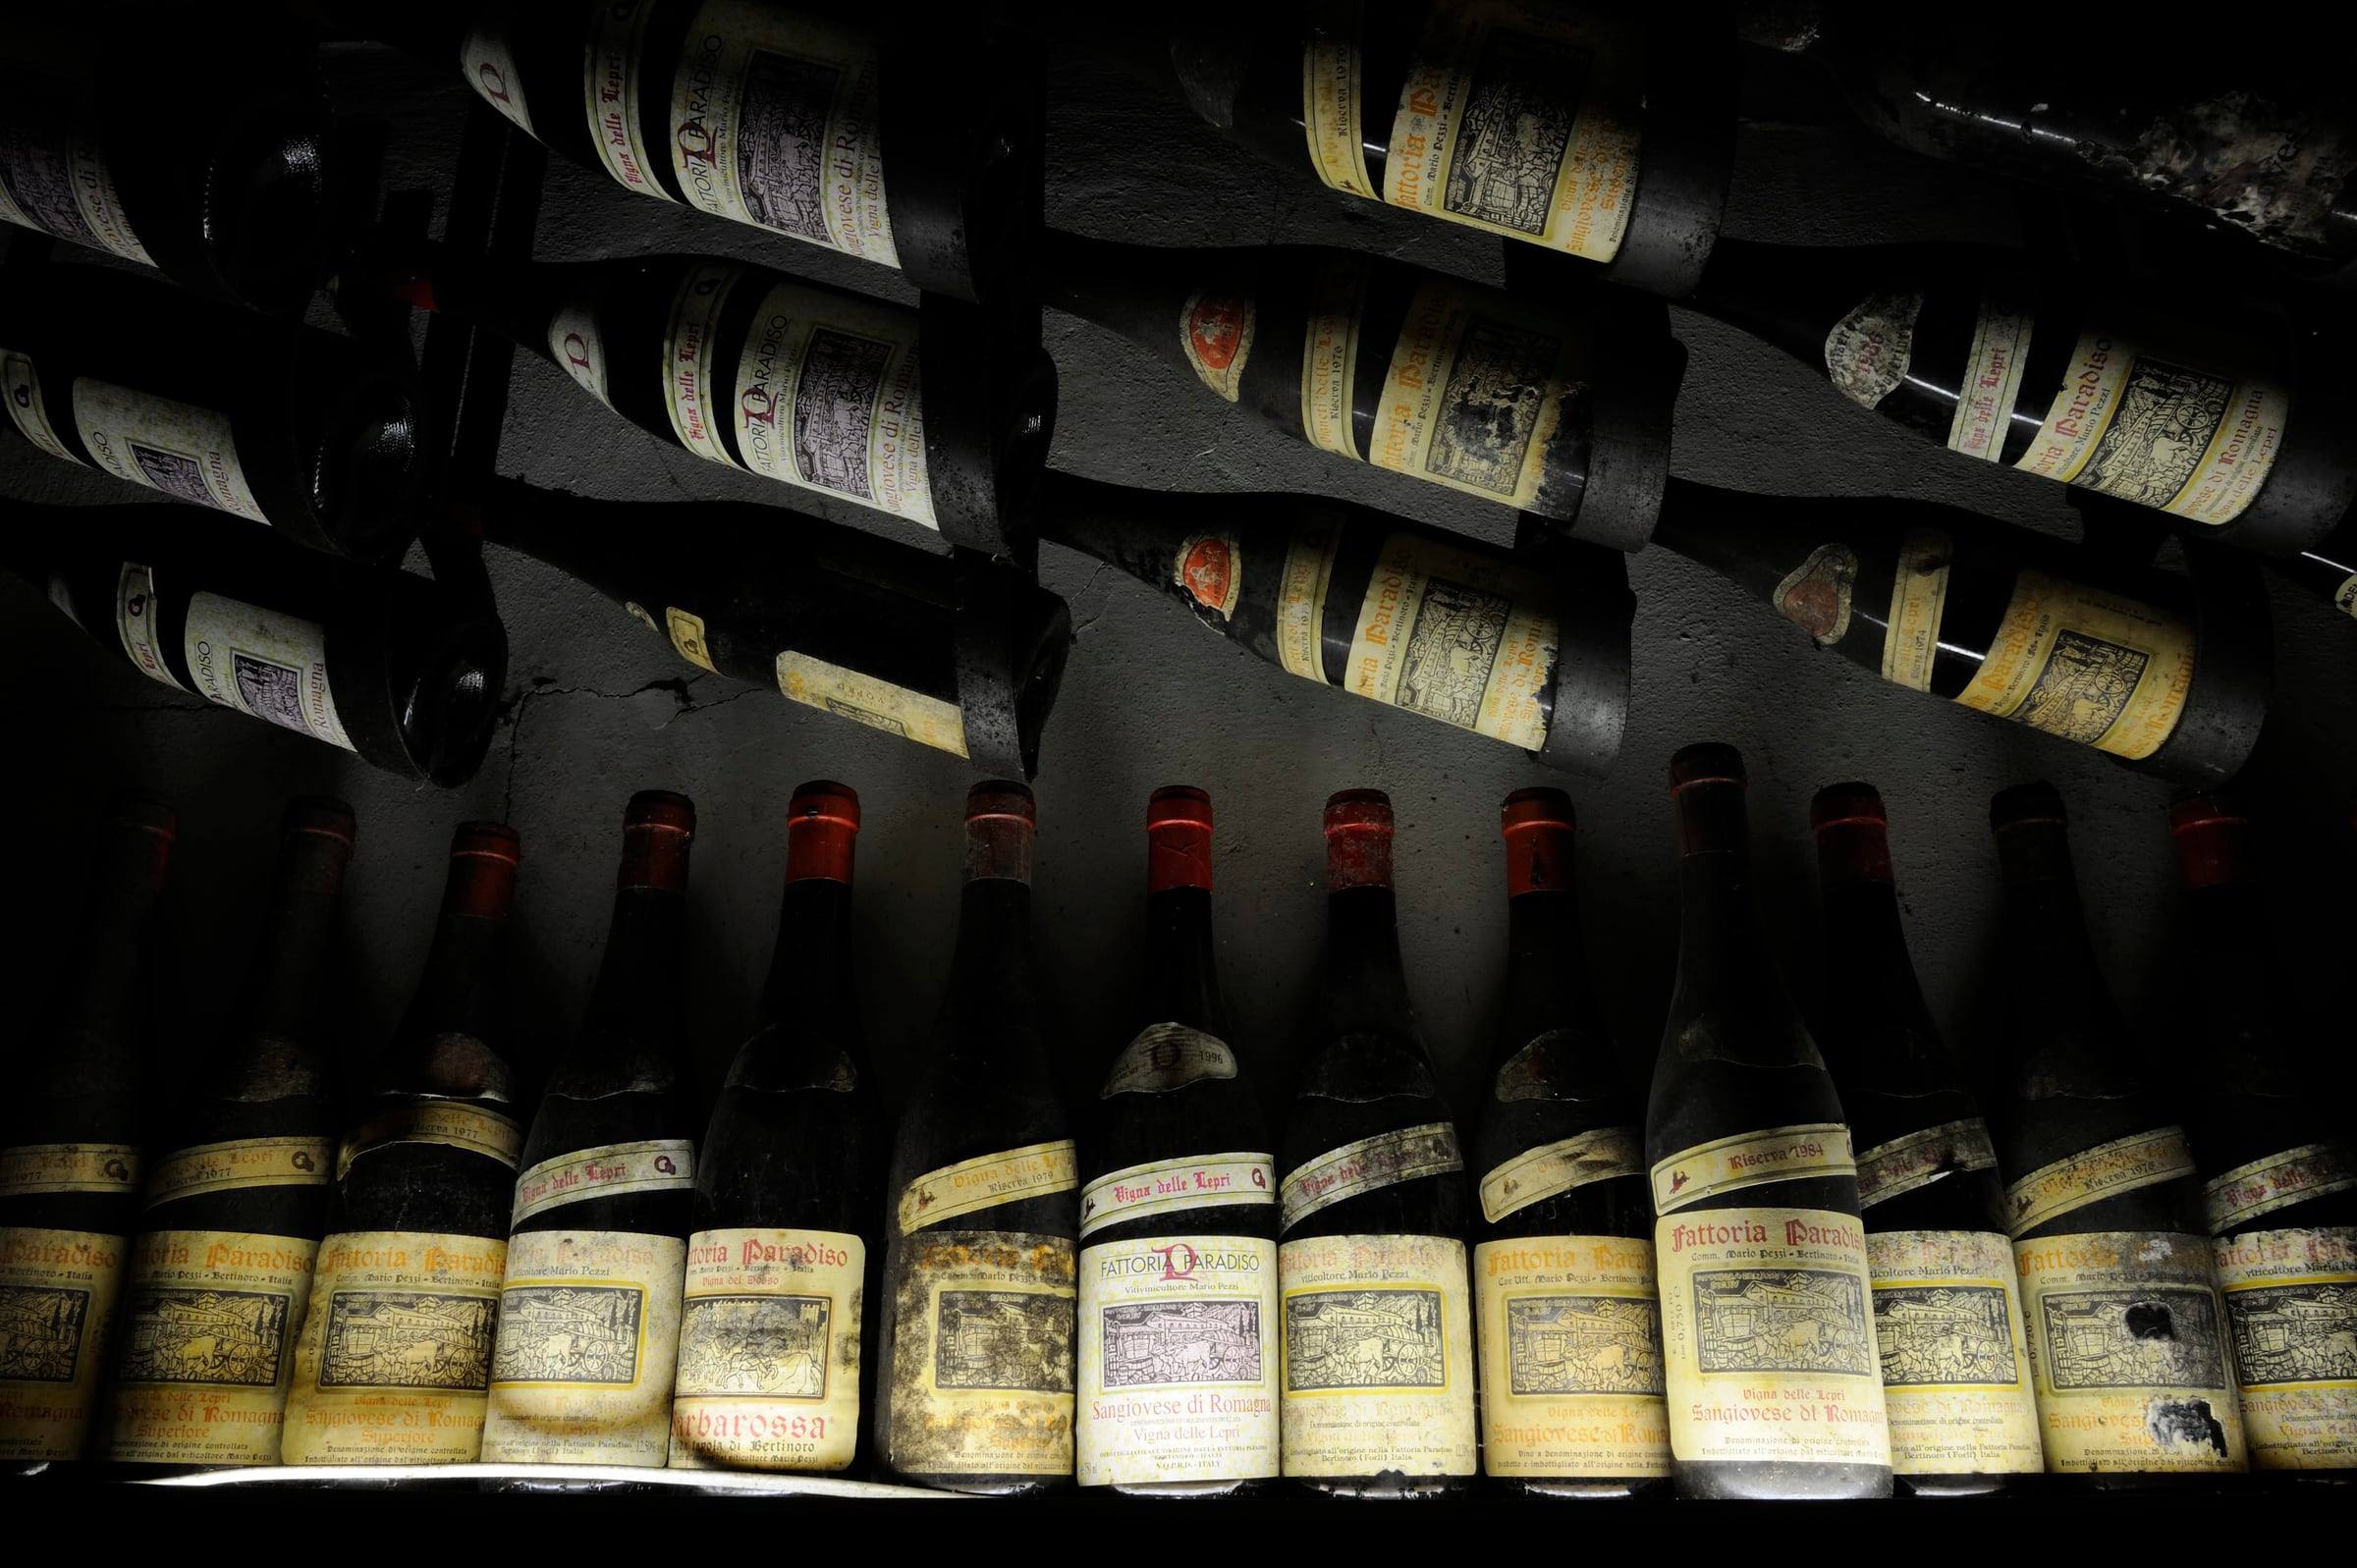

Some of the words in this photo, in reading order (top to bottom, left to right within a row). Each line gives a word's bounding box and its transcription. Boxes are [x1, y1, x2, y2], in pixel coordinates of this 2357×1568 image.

[689, 35, 722, 139] PARADISO
[605, 113, 626, 146] delle
[752, 315, 788, 403] PARADISO
[680, 370, 694, 402] delle
[2056, 339, 2111, 437] Paradiso
[1727, 1149, 1788, 1169] Riserva
[1790, 1142, 1824, 1159] 1984
[552, 1170, 578, 1191] delle
[988, 1177, 1028, 1193] Riserva
[1115, 1186, 1150, 1203] Vigna
[1158, 1178, 1186, 1194] delle
[1193, 1170, 1231, 1191] Lepri
[1672, 1218, 1768, 1253] Fattoria
[206, 1240, 312, 1273] Paradiso
[424, 1247, 506, 1275] Paradis
[742, 1238, 848, 1268] Paradiso
[1488, 1248, 1575, 1276] Fattoria
[1726, 1249, 1756, 1259] Mario
[1760, 1248, 1787, 1259] Pezzi
[549, 1267, 578, 1275] Mario
[580, 1267, 610, 1276] Pezzi
[1101, 1254, 1174, 1277] FATTORIA
[1183, 1254, 1260, 1271] PARADISO
[1918, 1266, 1949, 1275] Mario
[1189, 1282, 1216, 1291] Mario
[1784, 1388, 1811, 1400] delle
[1816, 1389, 1846, 1401] Lepri
[177, 1404, 194, 1422] di
[404, 1410, 419, 1426] di
[1092, 1398, 1181, 1423] Sangiovese
[1187, 1393, 1203, 1413] di
[1210, 1394, 1272, 1417] Romagna
[1692, 1404, 1792, 1425] Sangiovese
[1799, 1404, 1817, 1422] di
[137, 1425, 210, 1439] Superiore
[1133, 1428, 1171, 1443] Vigna
[1174, 1426, 1207, 1439] delle
[1210, 1425, 1240, 1439] Lepri
[1492, 1424, 1603, 1447] Sangiovese
[729, 1439, 740, 1450] di
[749, 1439, 814, 1452] Bertinoro
